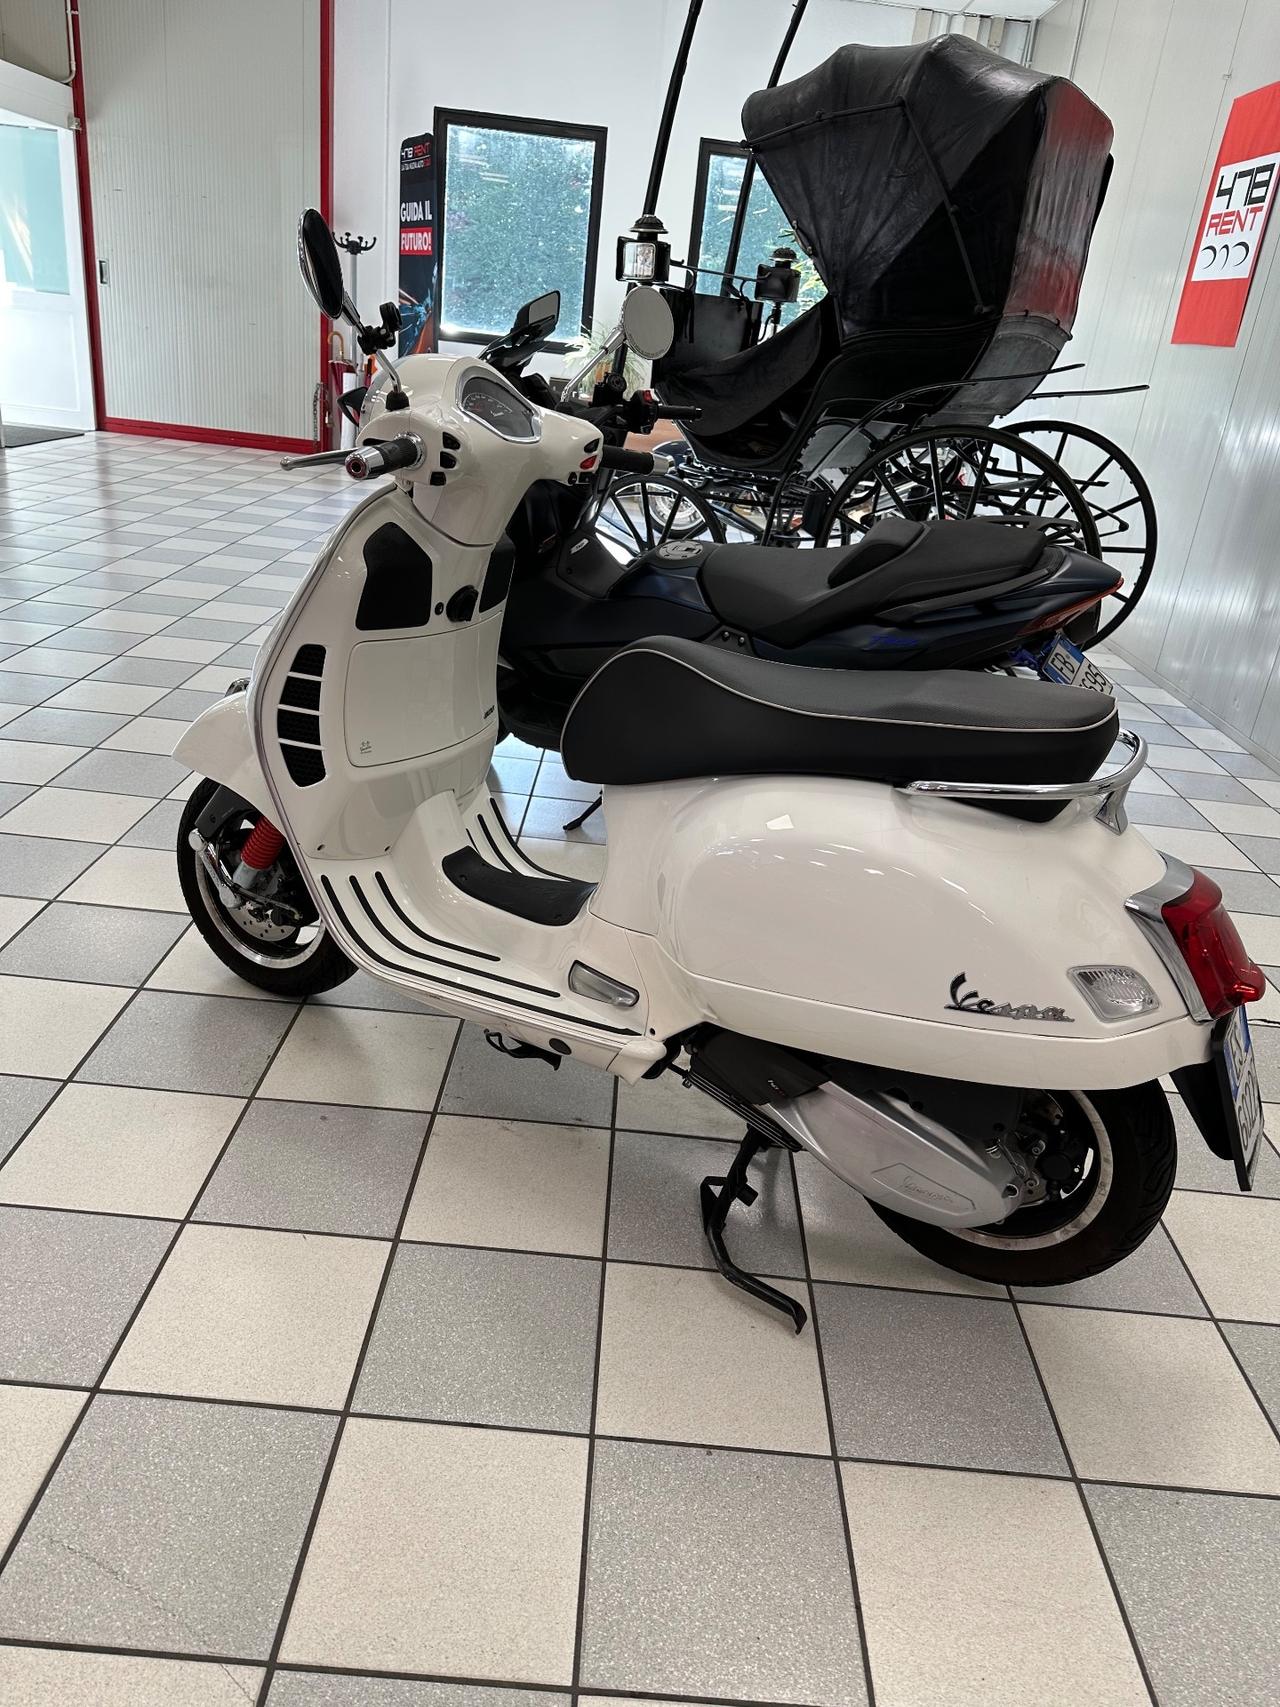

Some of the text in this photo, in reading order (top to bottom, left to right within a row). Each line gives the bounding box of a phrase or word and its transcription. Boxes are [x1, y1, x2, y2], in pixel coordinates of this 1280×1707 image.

[1216, 163, 1276, 210] 478
[400, 200, 433, 222] GUIDA IL
[1206, 206, 1264, 237] RENT
[401, 231, 432, 251] FUTURO!
[1050, 652, 1075, 682] FB
[944, 971, 1075, 1022] Vespa
